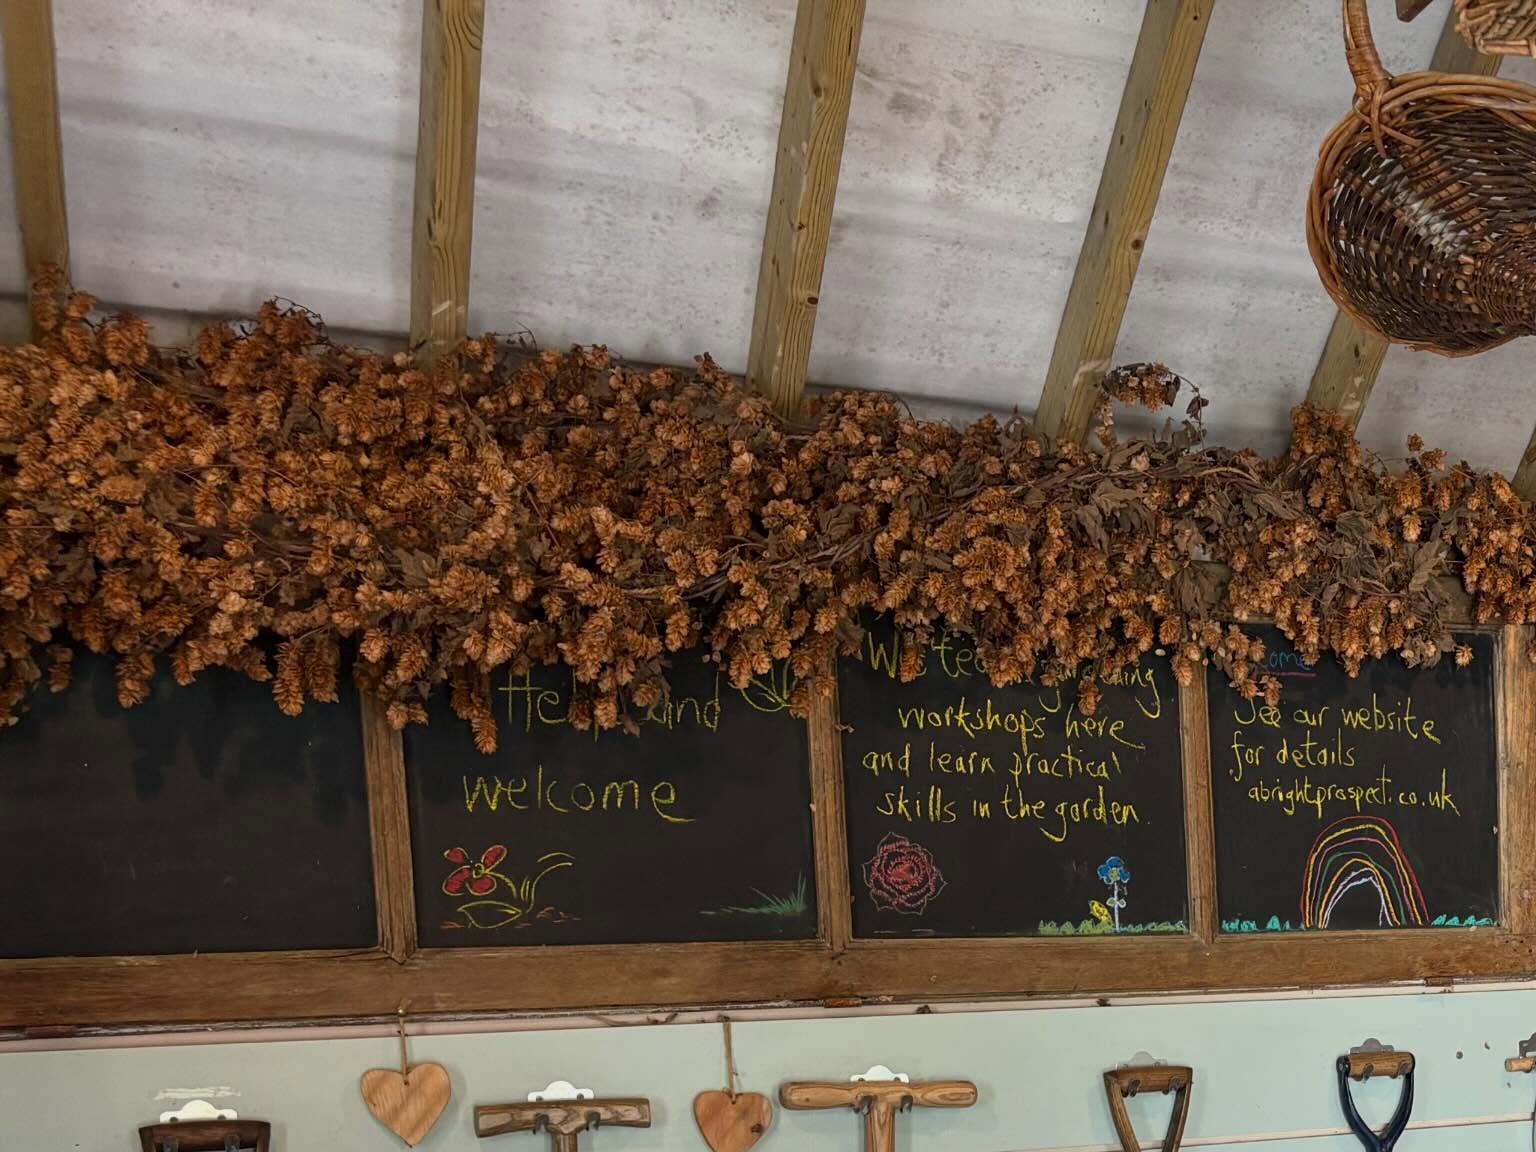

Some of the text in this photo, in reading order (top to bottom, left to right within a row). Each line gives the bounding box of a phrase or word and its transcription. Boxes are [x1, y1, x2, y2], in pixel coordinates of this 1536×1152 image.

[897, 697, 1146, 756] workshops here
[1293, 706, 1330, 728] our
[1341, 692, 1442, 745] website
[862, 741, 1121, 789] and learn practical
[1231, 727, 1356, 782] for details
[876, 785, 958, 823] skills
[972, 798, 992, 819] in
[1000, 784, 1048, 819] the
